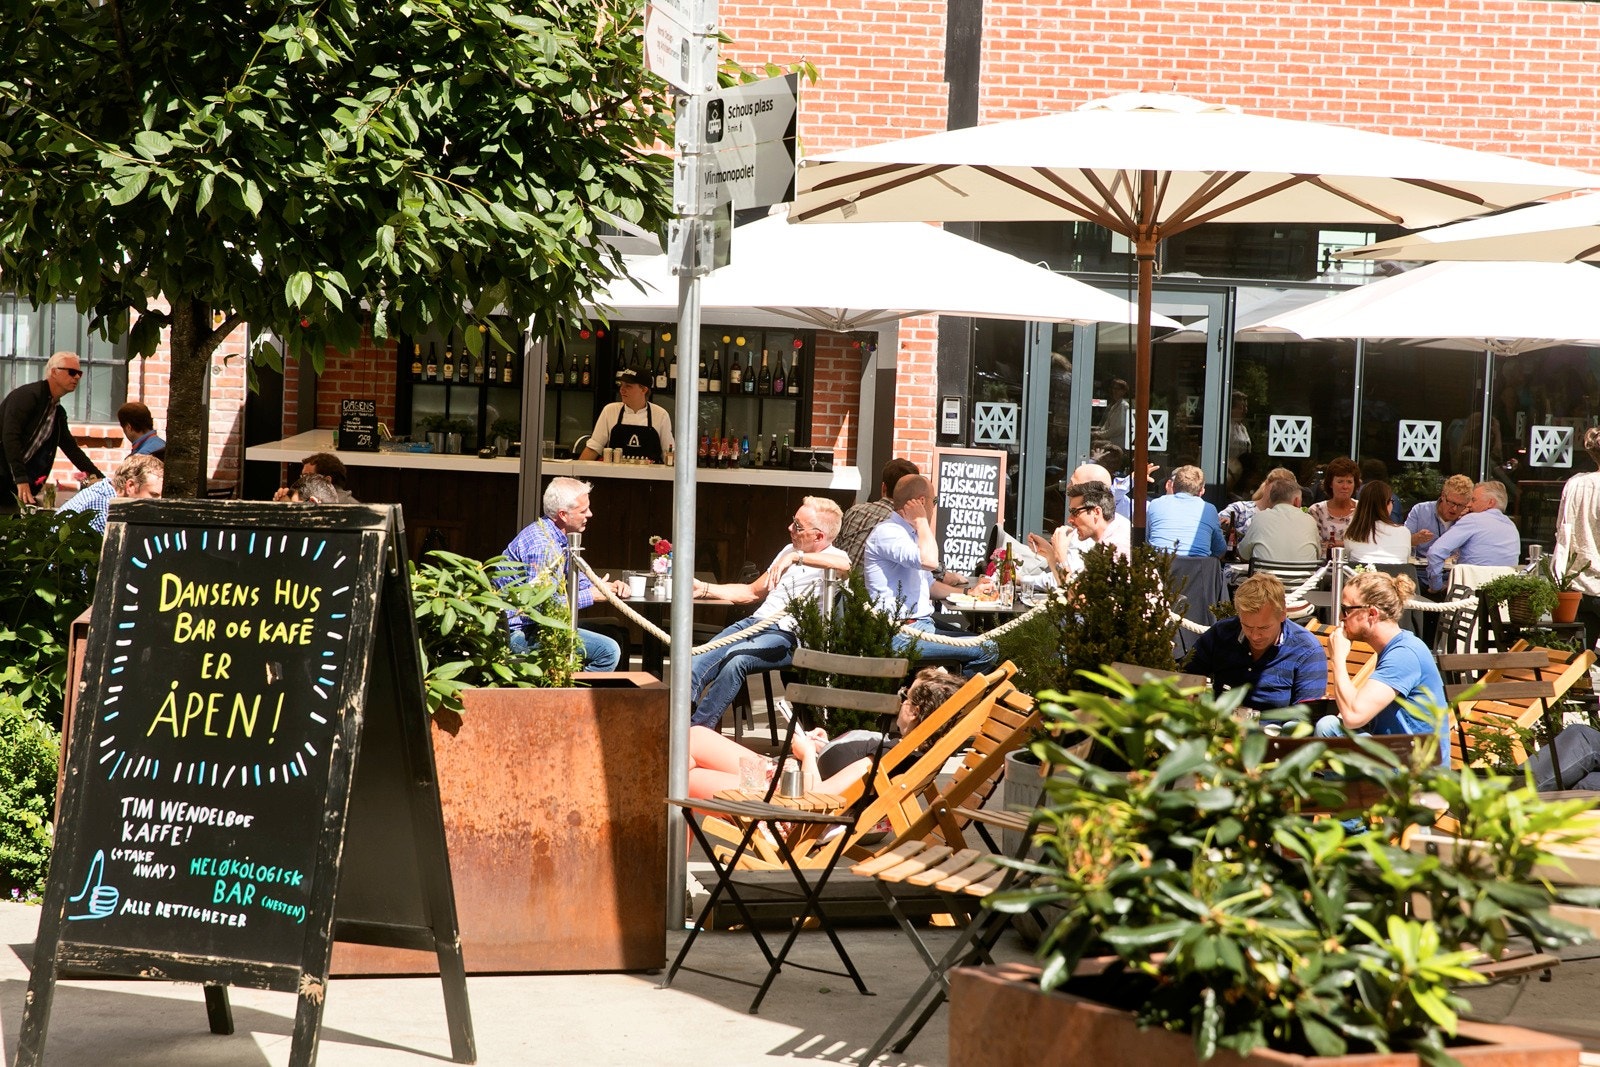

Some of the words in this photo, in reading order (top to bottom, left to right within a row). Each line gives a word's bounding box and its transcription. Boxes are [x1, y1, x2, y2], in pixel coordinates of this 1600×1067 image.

[728, 103, 753, 119] Schous
[754, 98, 774, 117] plass
[704, 163, 754, 185] Vinmonopolet
[343, 400, 375, 410] DAGENS
[950, 508, 985, 526] REKER
[945, 523, 987, 539] SCAMPI
[943, 538, 987, 556] ØSTERS
[159, 573, 260, 612] DANSENS
[274, 579, 322, 612] HUS
[174, 612, 216, 643] BAR
[226, 620, 251, 638] OG
[258, 618, 315, 645] KAFÉ
[201, 653, 232, 679] ER
[121, 797, 153, 819] TIM
[160, 800, 254, 828] WENDELBOE
[121, 821, 193, 846] KAFFE!
[133, 862, 176, 880] AWAY)
[190, 857, 304, 886] HELØKOLOGISK
[120, 898, 151, 916] ALLE
[155, 900, 247, 928] RETTIGHETER
[213, 880, 256, 906] BAR
[261, 895, 306, 924] (NESTEN)
